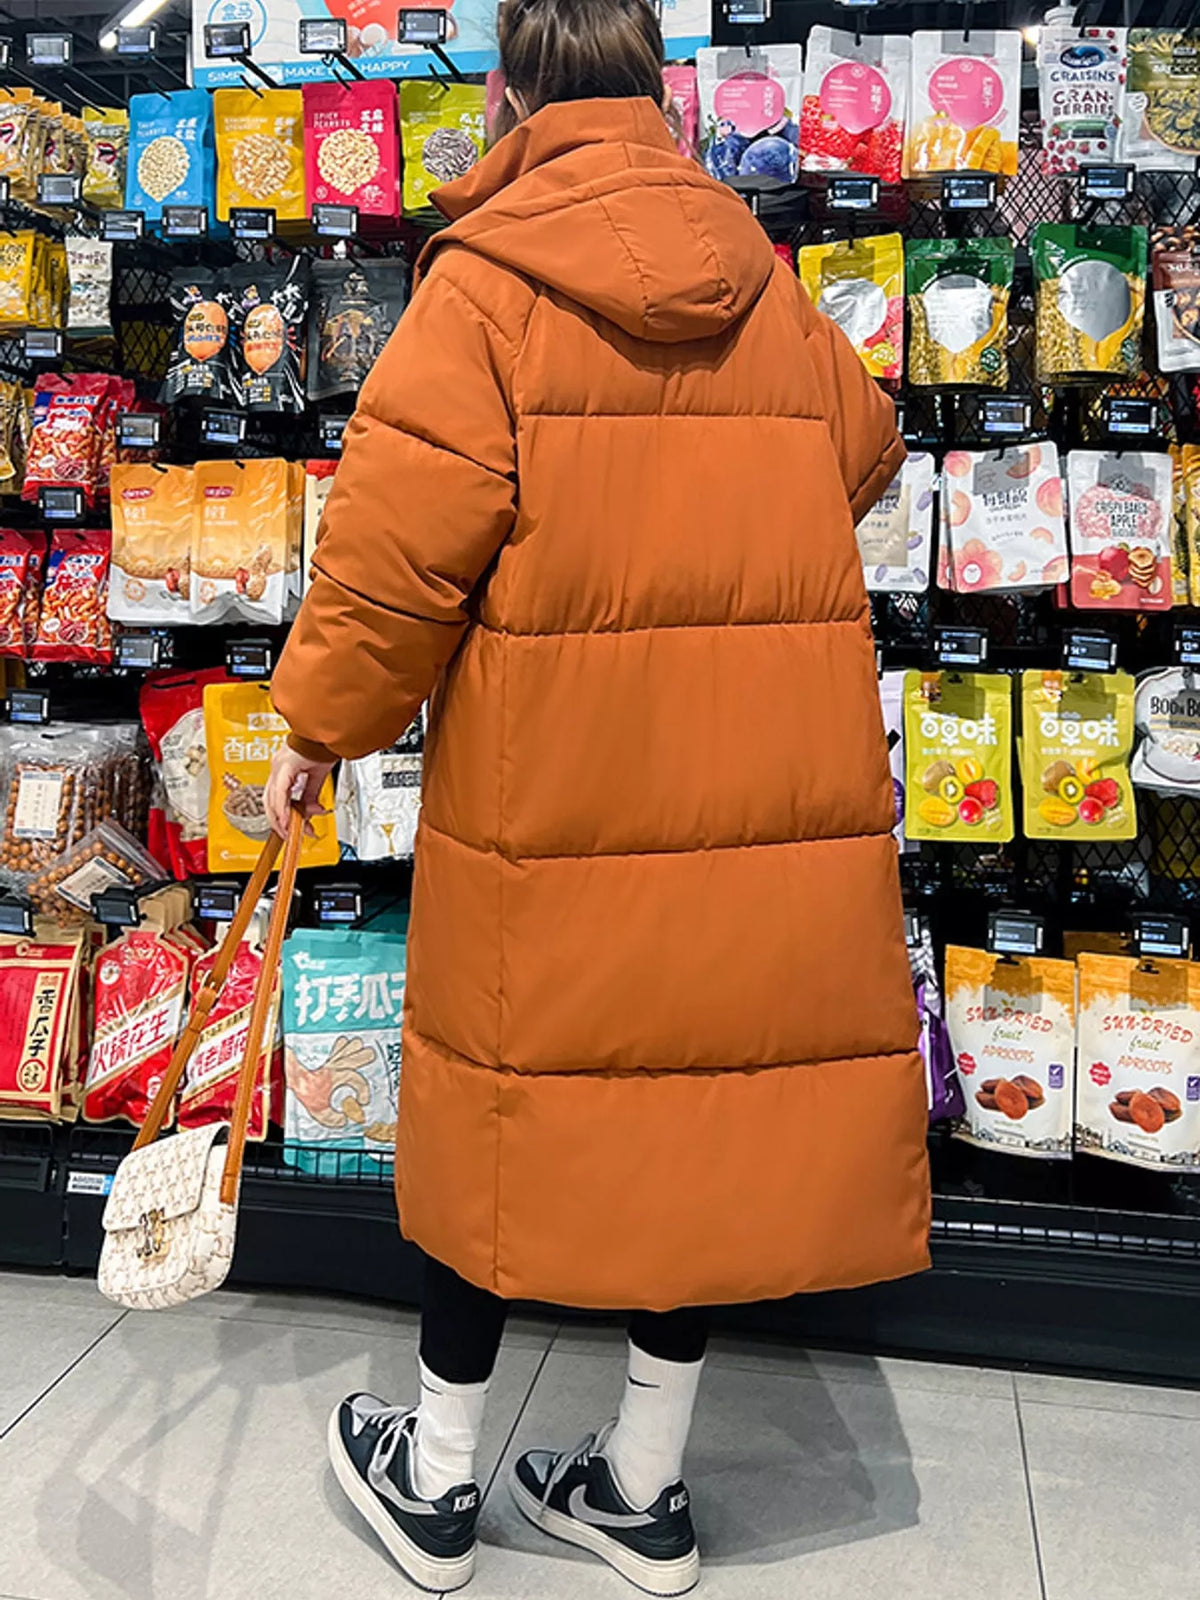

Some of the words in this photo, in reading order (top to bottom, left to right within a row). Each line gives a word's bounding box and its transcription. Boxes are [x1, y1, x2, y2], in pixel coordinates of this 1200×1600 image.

[361, 60, 411, 74] HAPPY
[1051, 71, 1116, 82] CRAISINS
[1053, 90, 1114, 104] CRAN-
[1053, 103, 1113, 118] BERRIES
[1110, 514, 1137, 528] APPLE
[965, 1006, 1053, 1033] SUN-DRIED
[1103, 1015, 1193, 1043] SUN-DRIED
[92, 1008, 170, 1080] 火锅花生
[1117, 1054, 1173, 1075] APRICOTS
